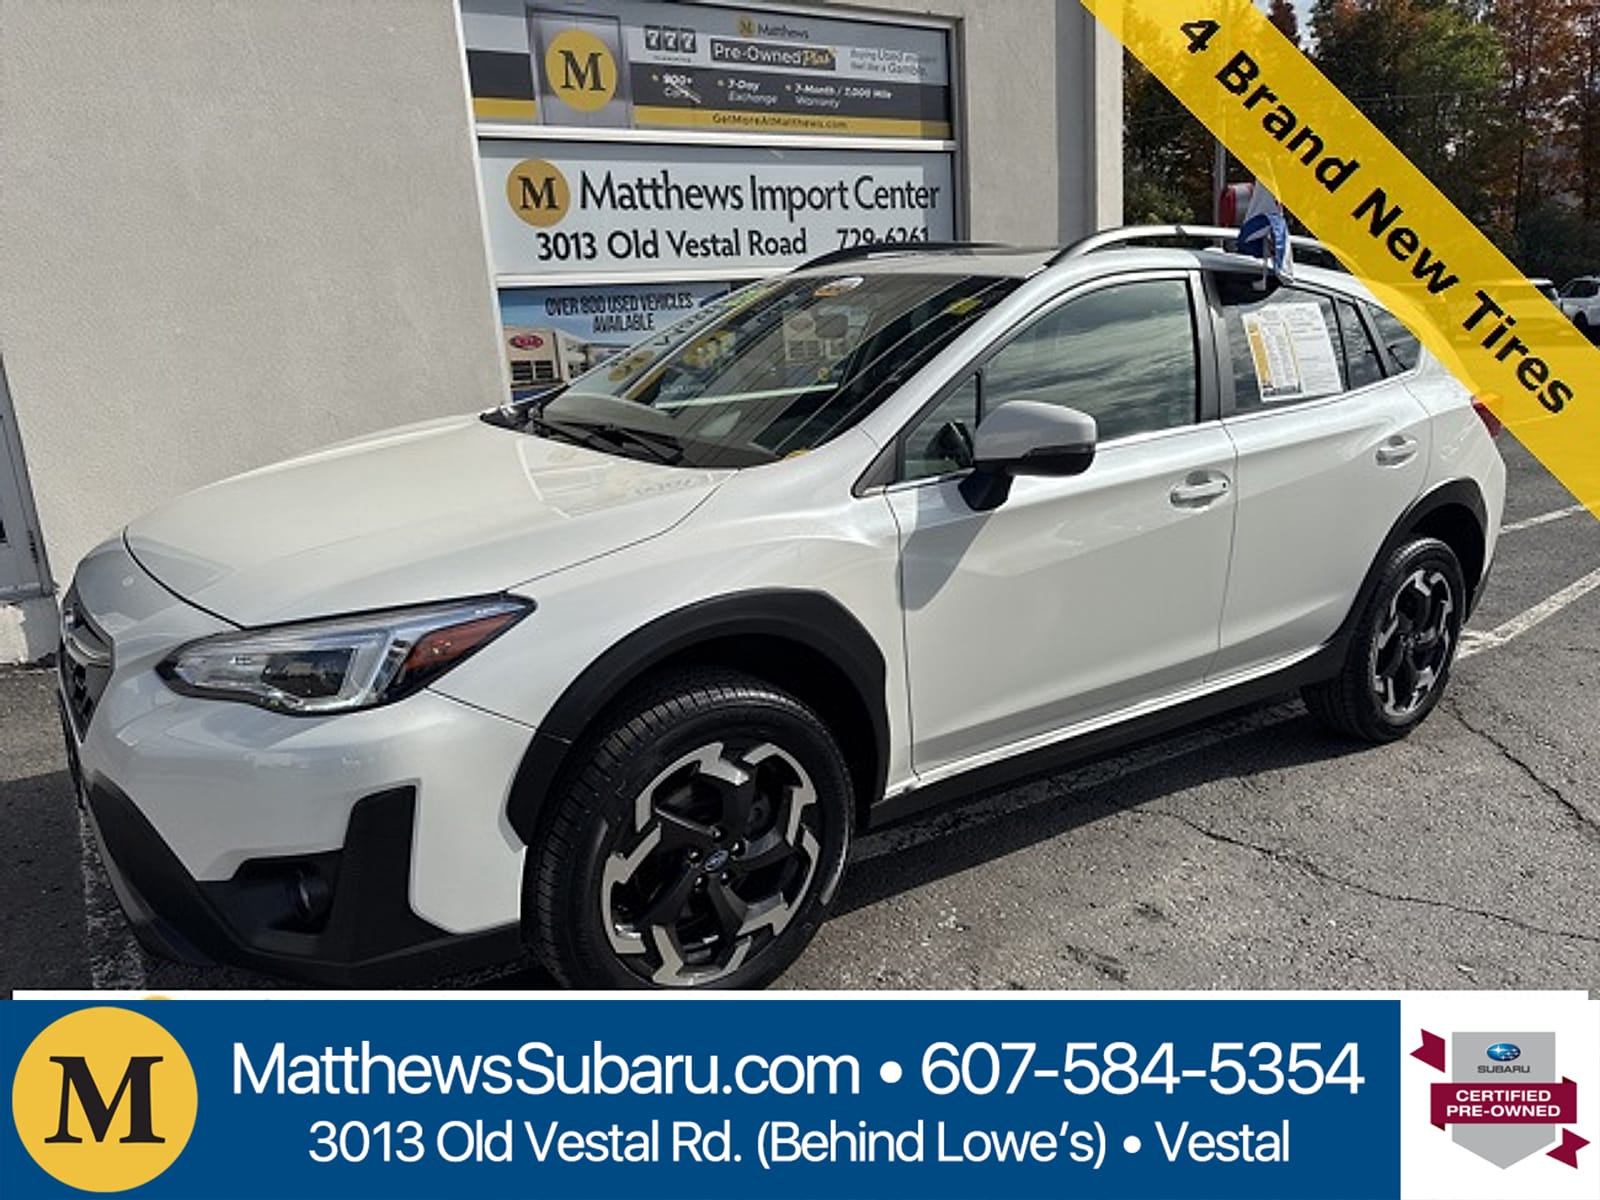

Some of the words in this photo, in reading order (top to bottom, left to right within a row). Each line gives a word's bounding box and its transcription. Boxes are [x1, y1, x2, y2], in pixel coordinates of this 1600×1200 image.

[757, 23, 810, 39] Matthews
[713, 42, 801, 66] Pre-Owned
[559, 50, 606, 91] M
[712, 112, 847, 130] GetMoreAtMatthews.com
[518, 176, 559, 210] M
[580, 170, 744, 210] Matthews
[750, 174, 850, 222] Import
[854, 175, 941, 210] Center
[536, 231, 598, 261] 3013
[607, 230, 660, 260] Old
[667, 228, 742, 257] Vestal
[749, 228, 808, 255] Road
[544, 296, 579, 316] OVER
[607, 294, 639, 312] USED
[640, 292, 694, 311] VEHICLES
[592, 312, 656, 334] AVAILABLE
